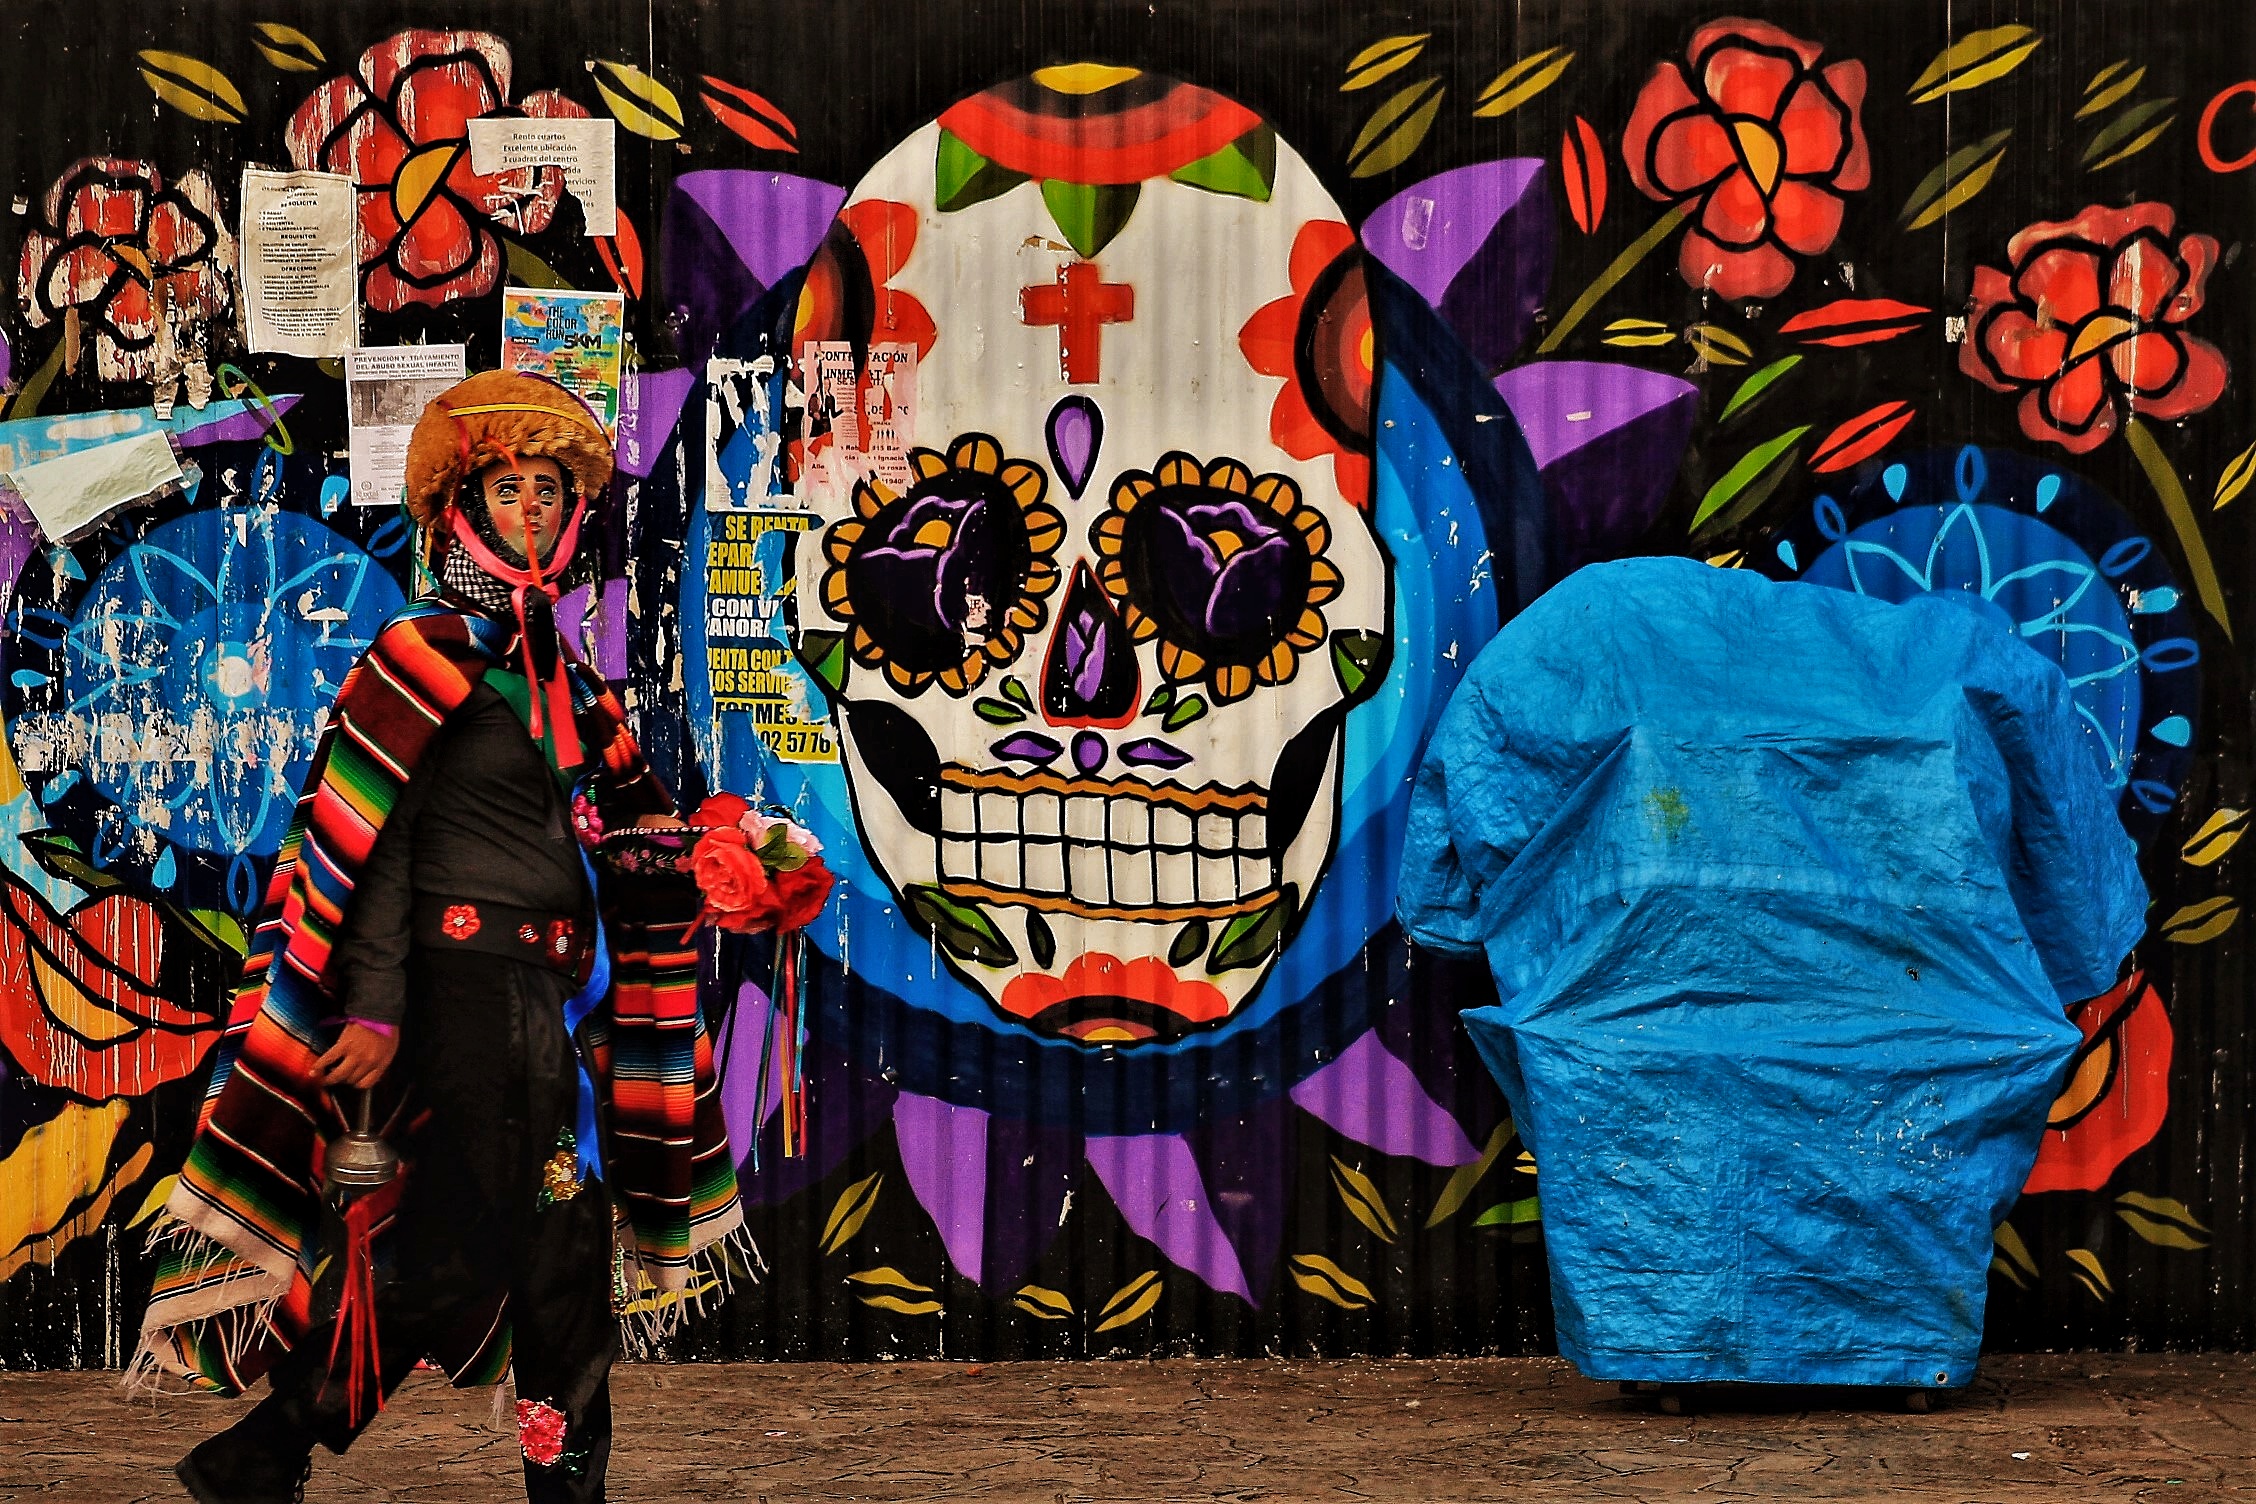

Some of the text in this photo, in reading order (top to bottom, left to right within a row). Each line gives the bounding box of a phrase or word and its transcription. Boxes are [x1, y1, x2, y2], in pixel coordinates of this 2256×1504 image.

[540, 144, 577, 152] ubicación
[509, 155, 538, 163] cuadras
[548, 306, 565, 318] THE
[547, 318, 577, 329] COLOR
[546, 328, 565, 340] RUN
[725, 515, 809, 541] SE RENTA
[708, 542, 755, 567] EPAR
[712, 598, 753, 617] CON
[738, 671, 792, 693] SERVIC
